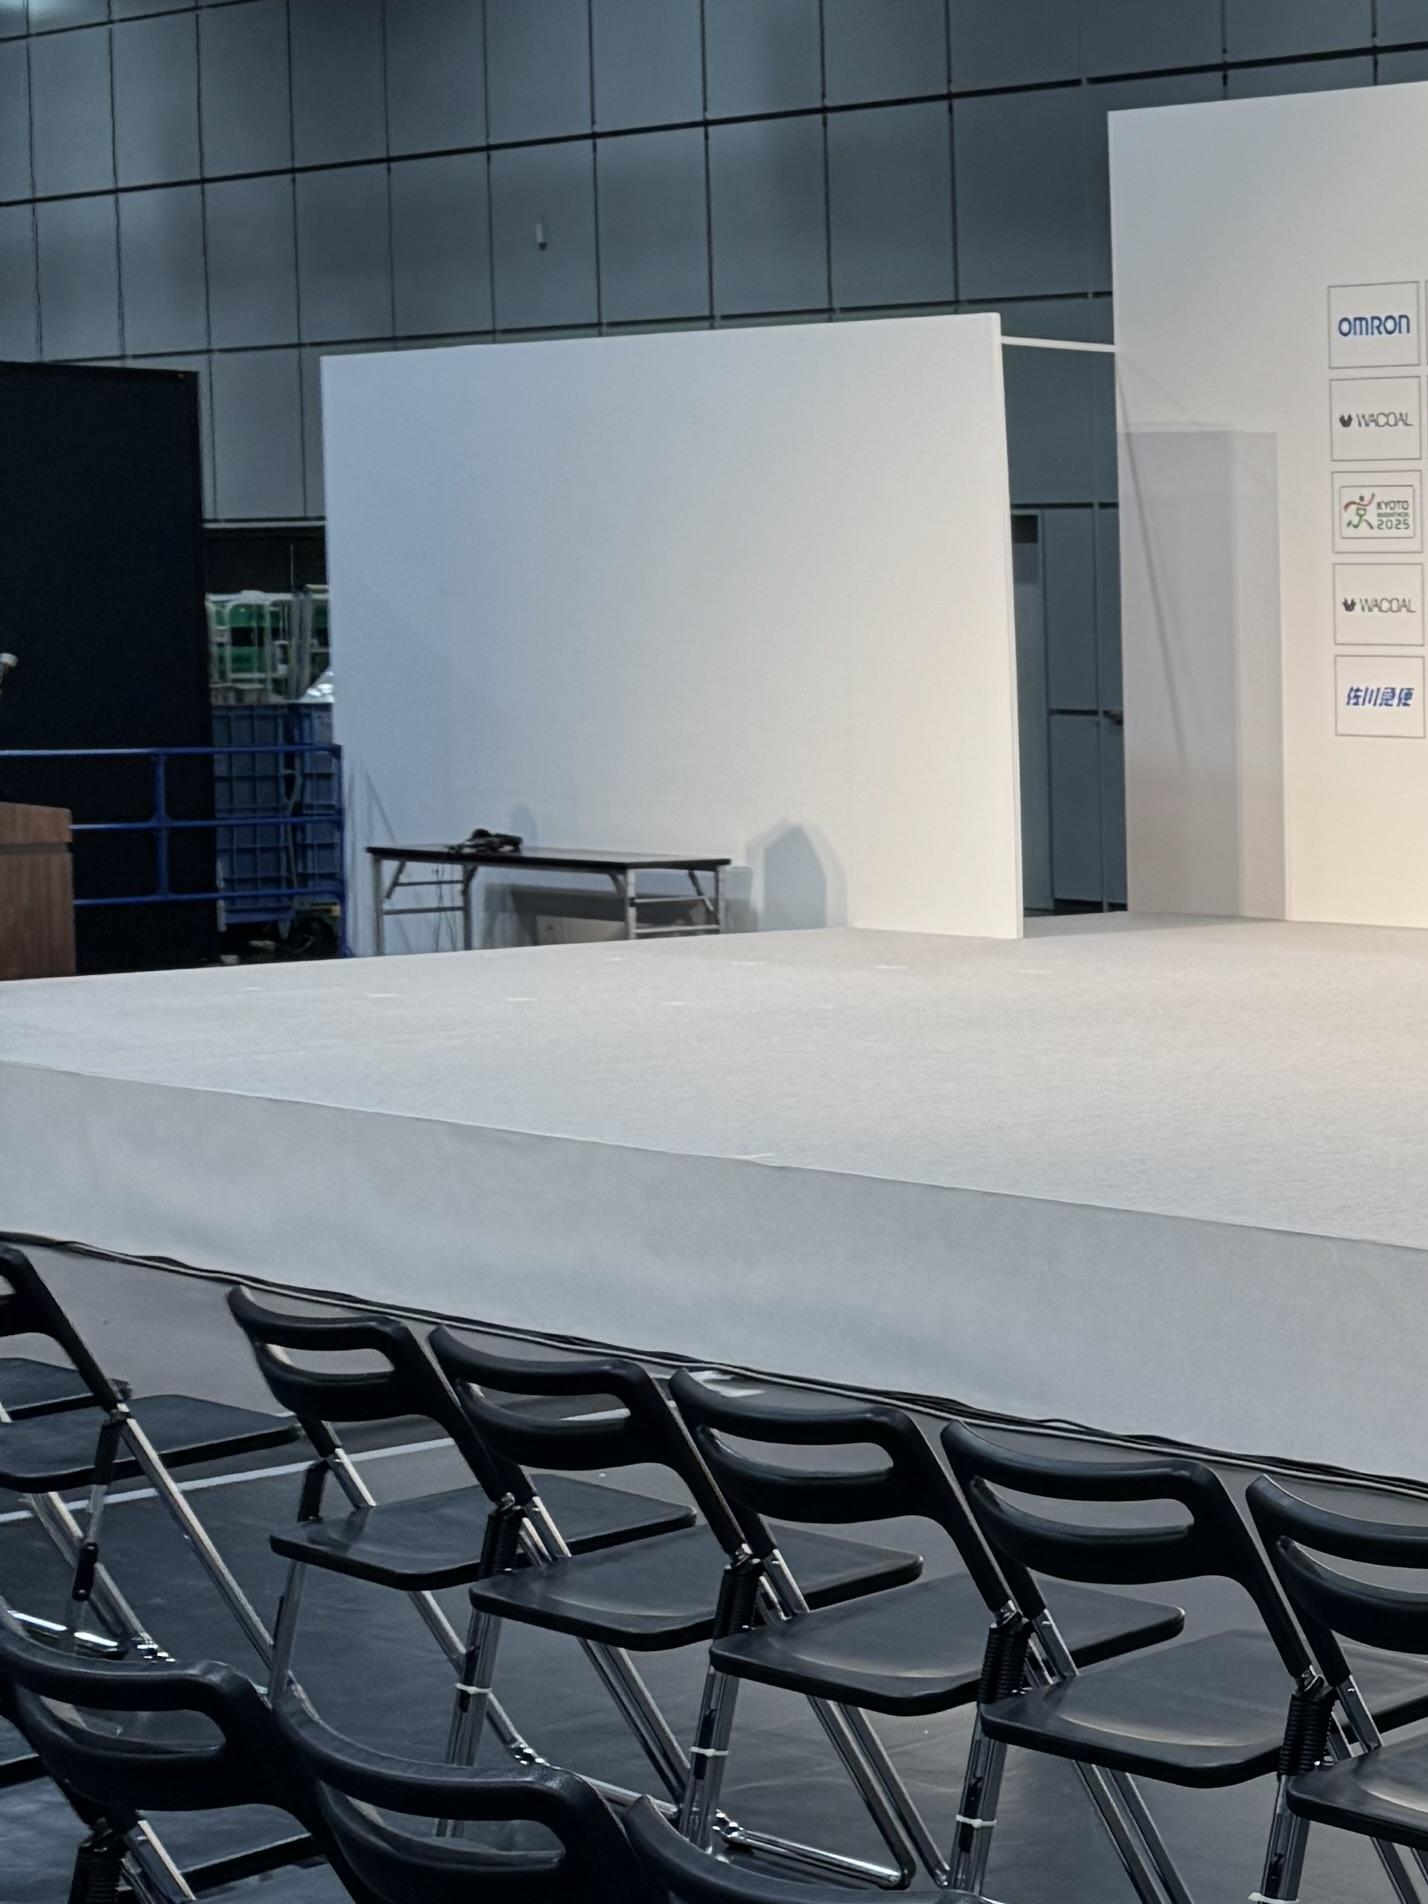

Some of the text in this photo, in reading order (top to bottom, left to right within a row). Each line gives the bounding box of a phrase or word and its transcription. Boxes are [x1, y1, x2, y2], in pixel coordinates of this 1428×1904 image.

[1338, 315, 1410, 337] OMRON
[1377, 500, 1409, 511] KYOTO
[1377, 518, 1410, 530] 2025
[1346, 687, 1414, 707] 佐川急便
